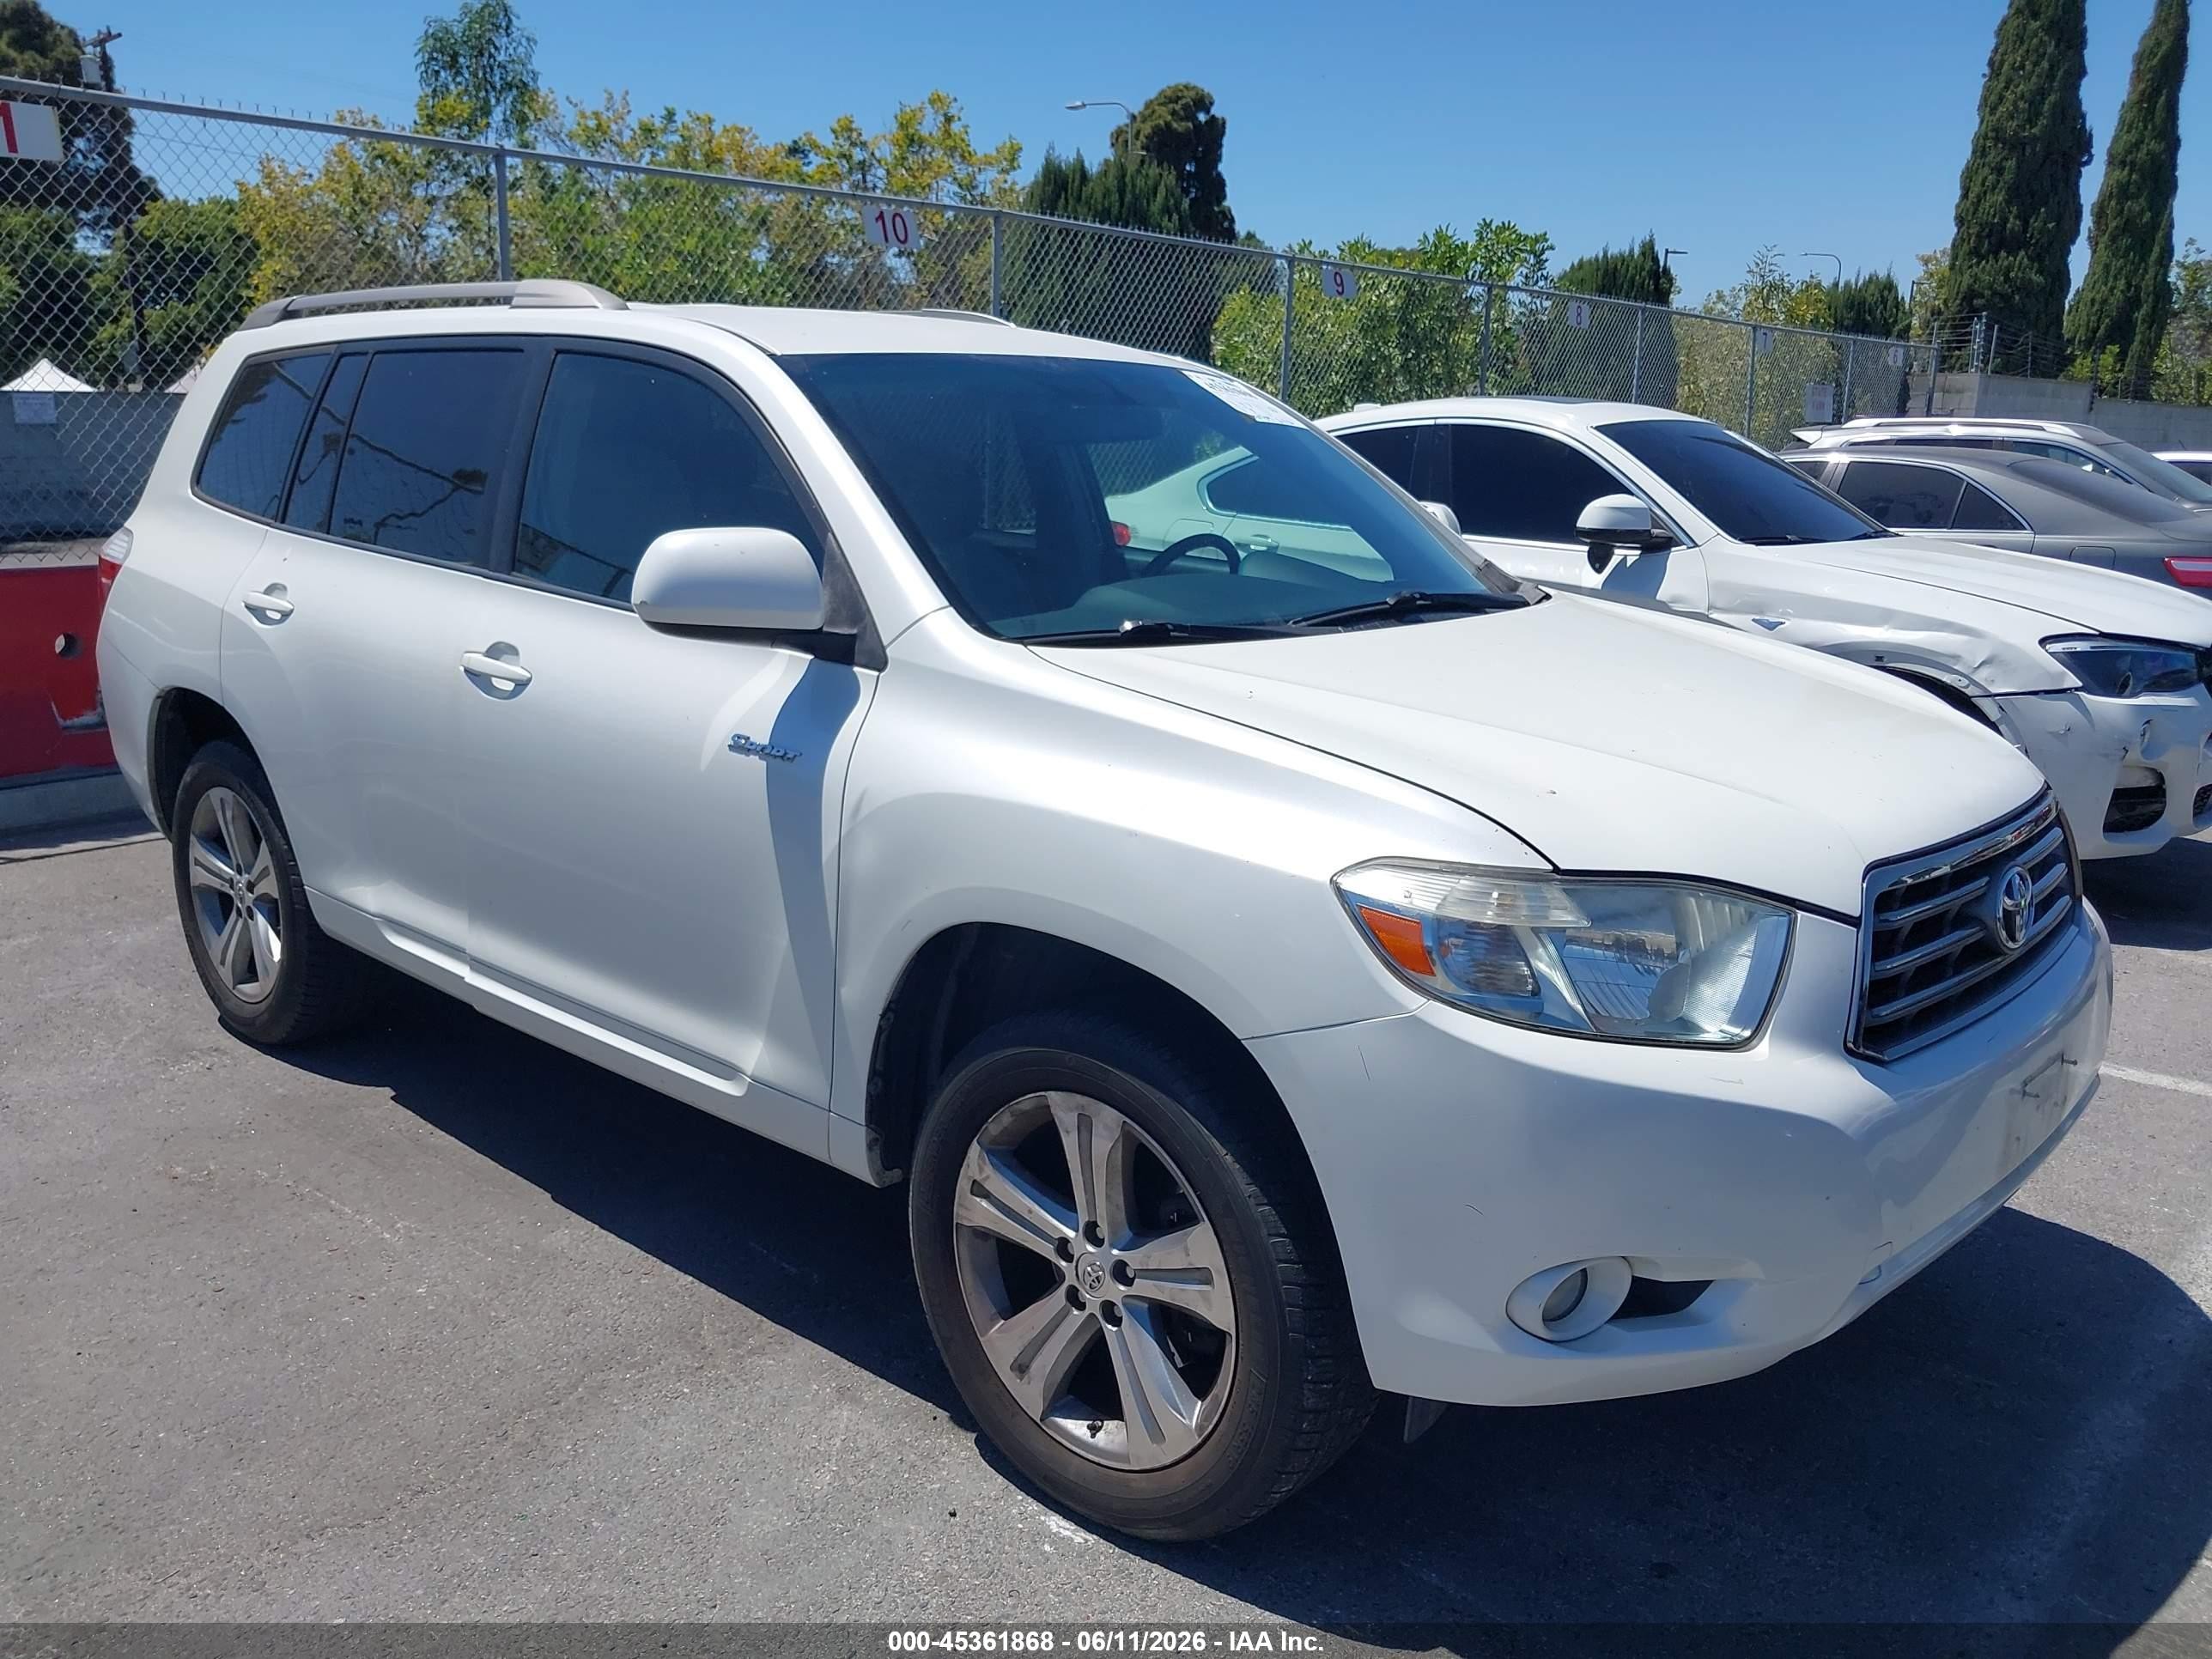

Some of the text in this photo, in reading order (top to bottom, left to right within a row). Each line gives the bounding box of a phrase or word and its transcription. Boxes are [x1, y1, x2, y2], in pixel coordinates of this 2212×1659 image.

[875, 210, 908, 245] 10
[1334, 271, 1345, 296] 9
[1576, 305, 1583, 325] 8
